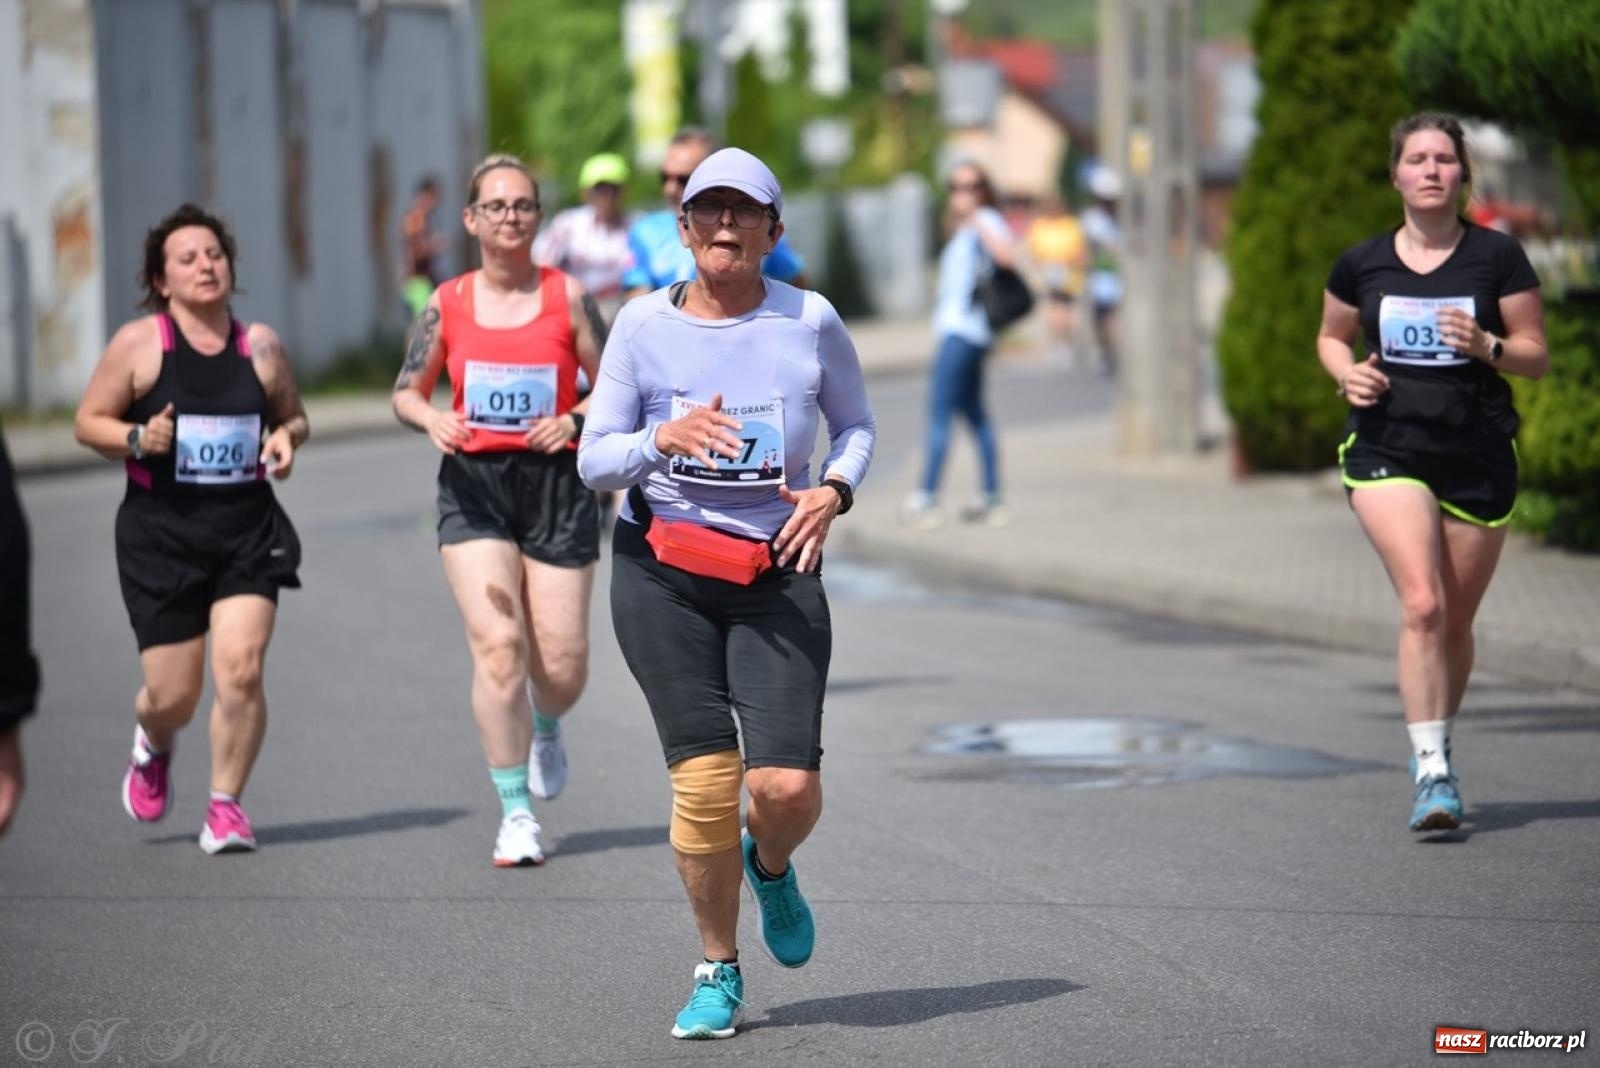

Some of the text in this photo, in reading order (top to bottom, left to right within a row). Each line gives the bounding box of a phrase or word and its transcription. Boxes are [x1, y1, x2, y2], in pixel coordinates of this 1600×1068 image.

[489, 391, 531, 413] 013
[721, 407, 738, 416] BEZ
[740, 403, 774, 415] GRANIC
[200, 443, 244, 464] 026
